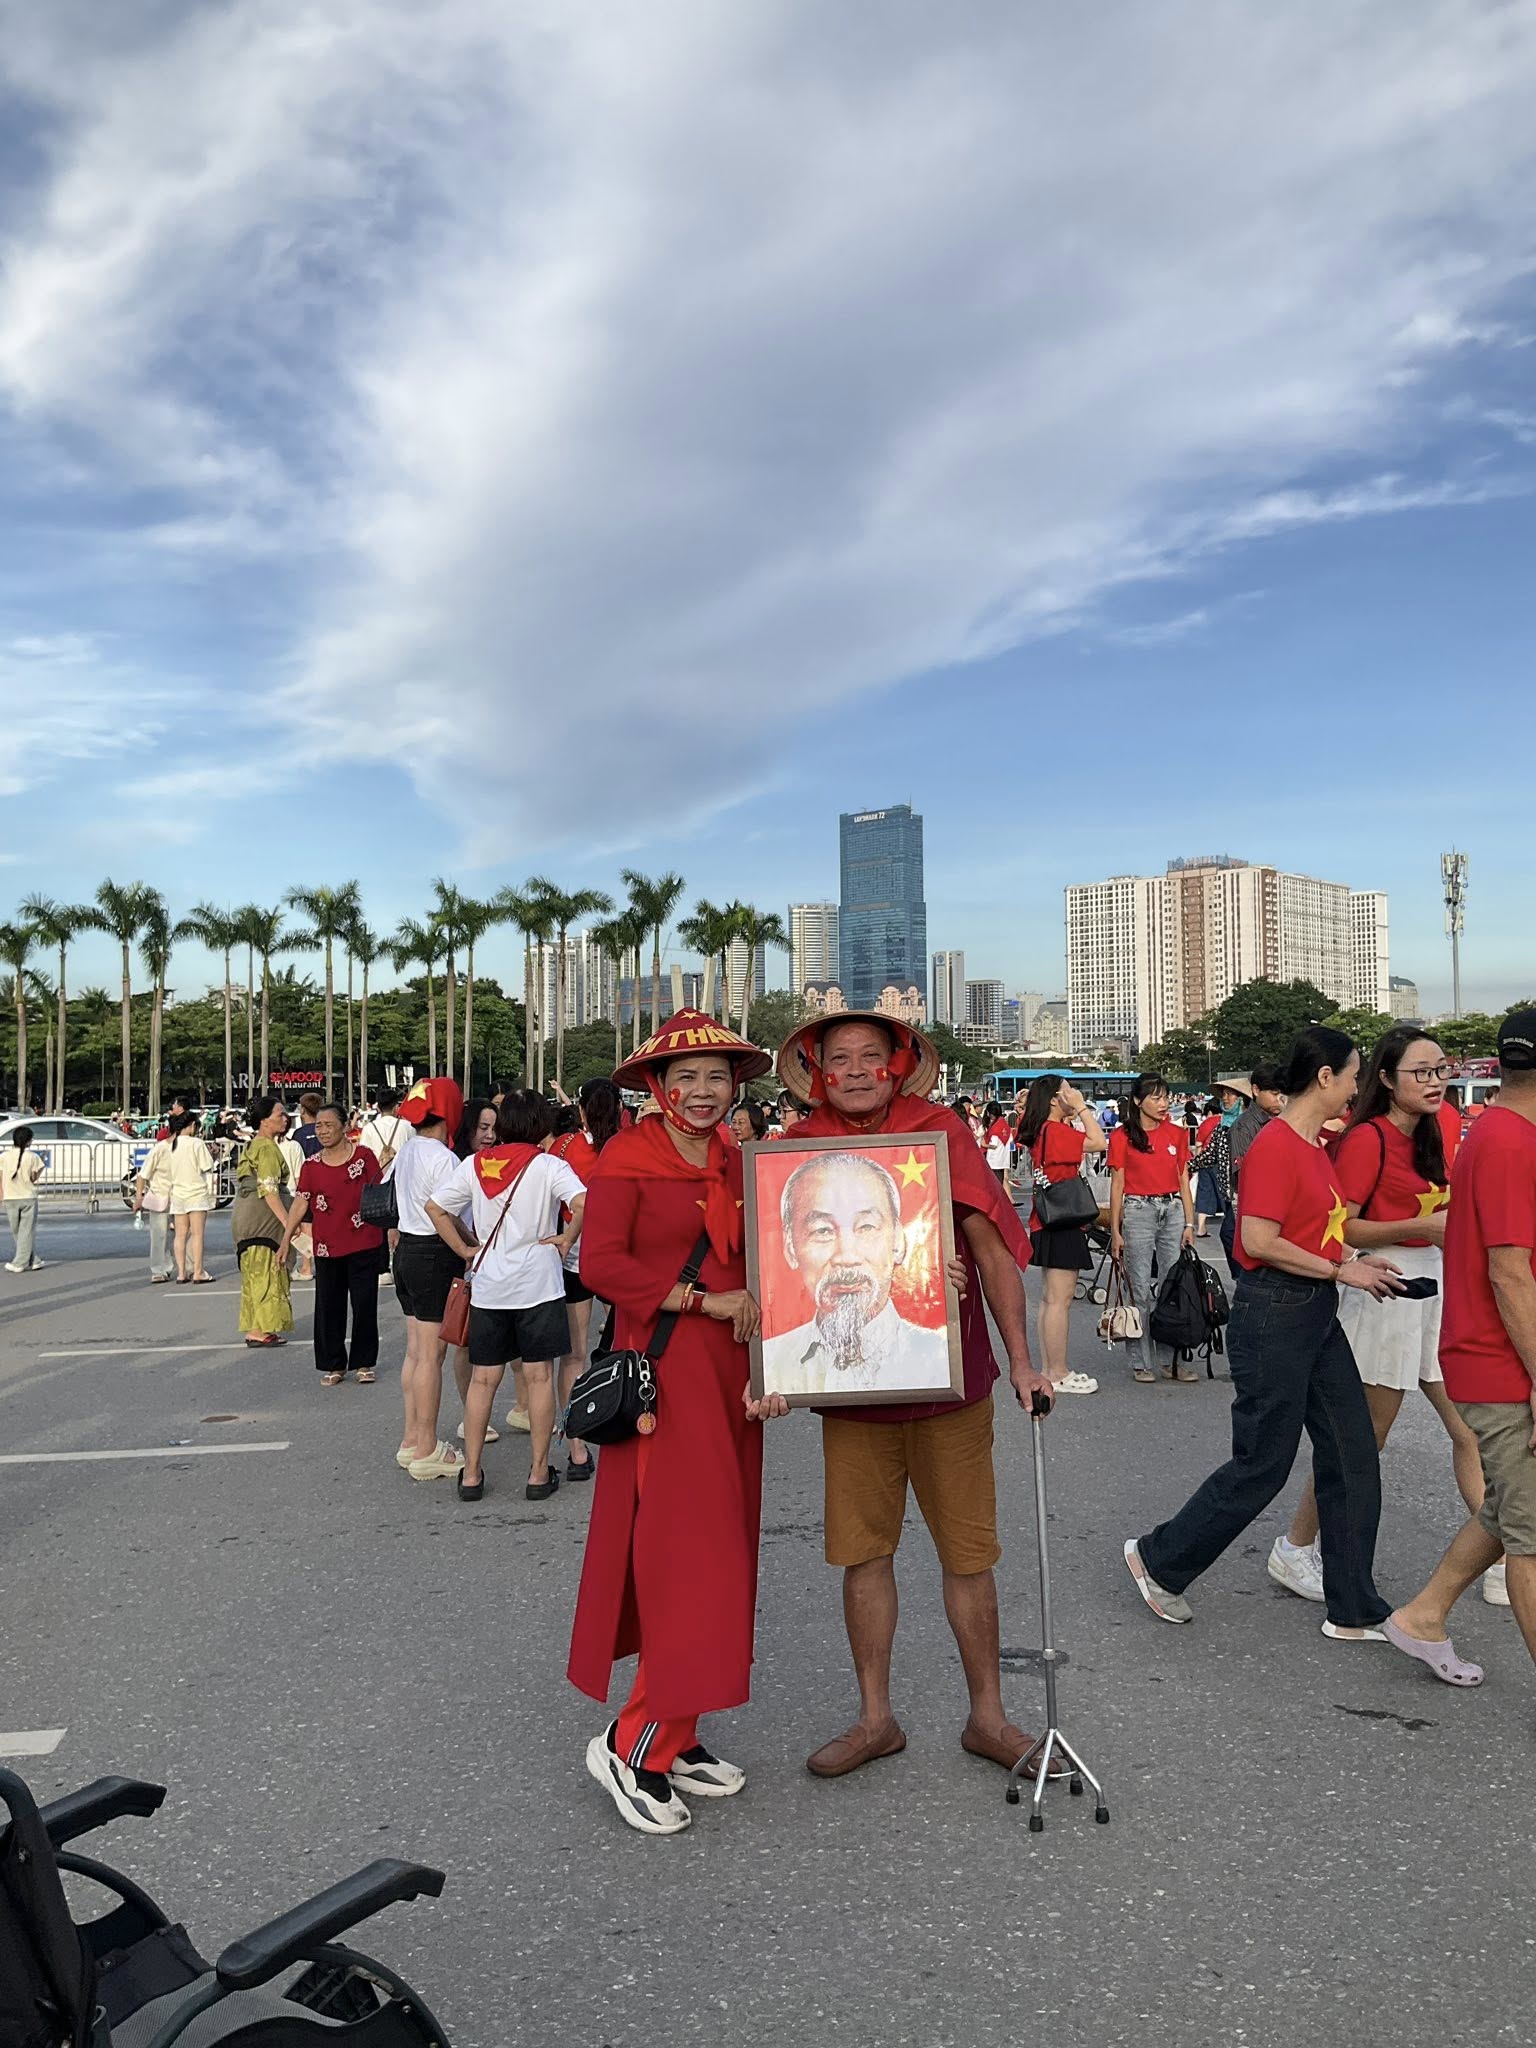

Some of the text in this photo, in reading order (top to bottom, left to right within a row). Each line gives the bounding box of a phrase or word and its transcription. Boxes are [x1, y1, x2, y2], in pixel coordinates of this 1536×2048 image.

[878, 811, 886, 819] 72
[668, 1023, 756, 1048] THẮN
[269, 1071, 324, 1082] SEAFOOD
[274, 1080, 321, 1089] Restaurant
